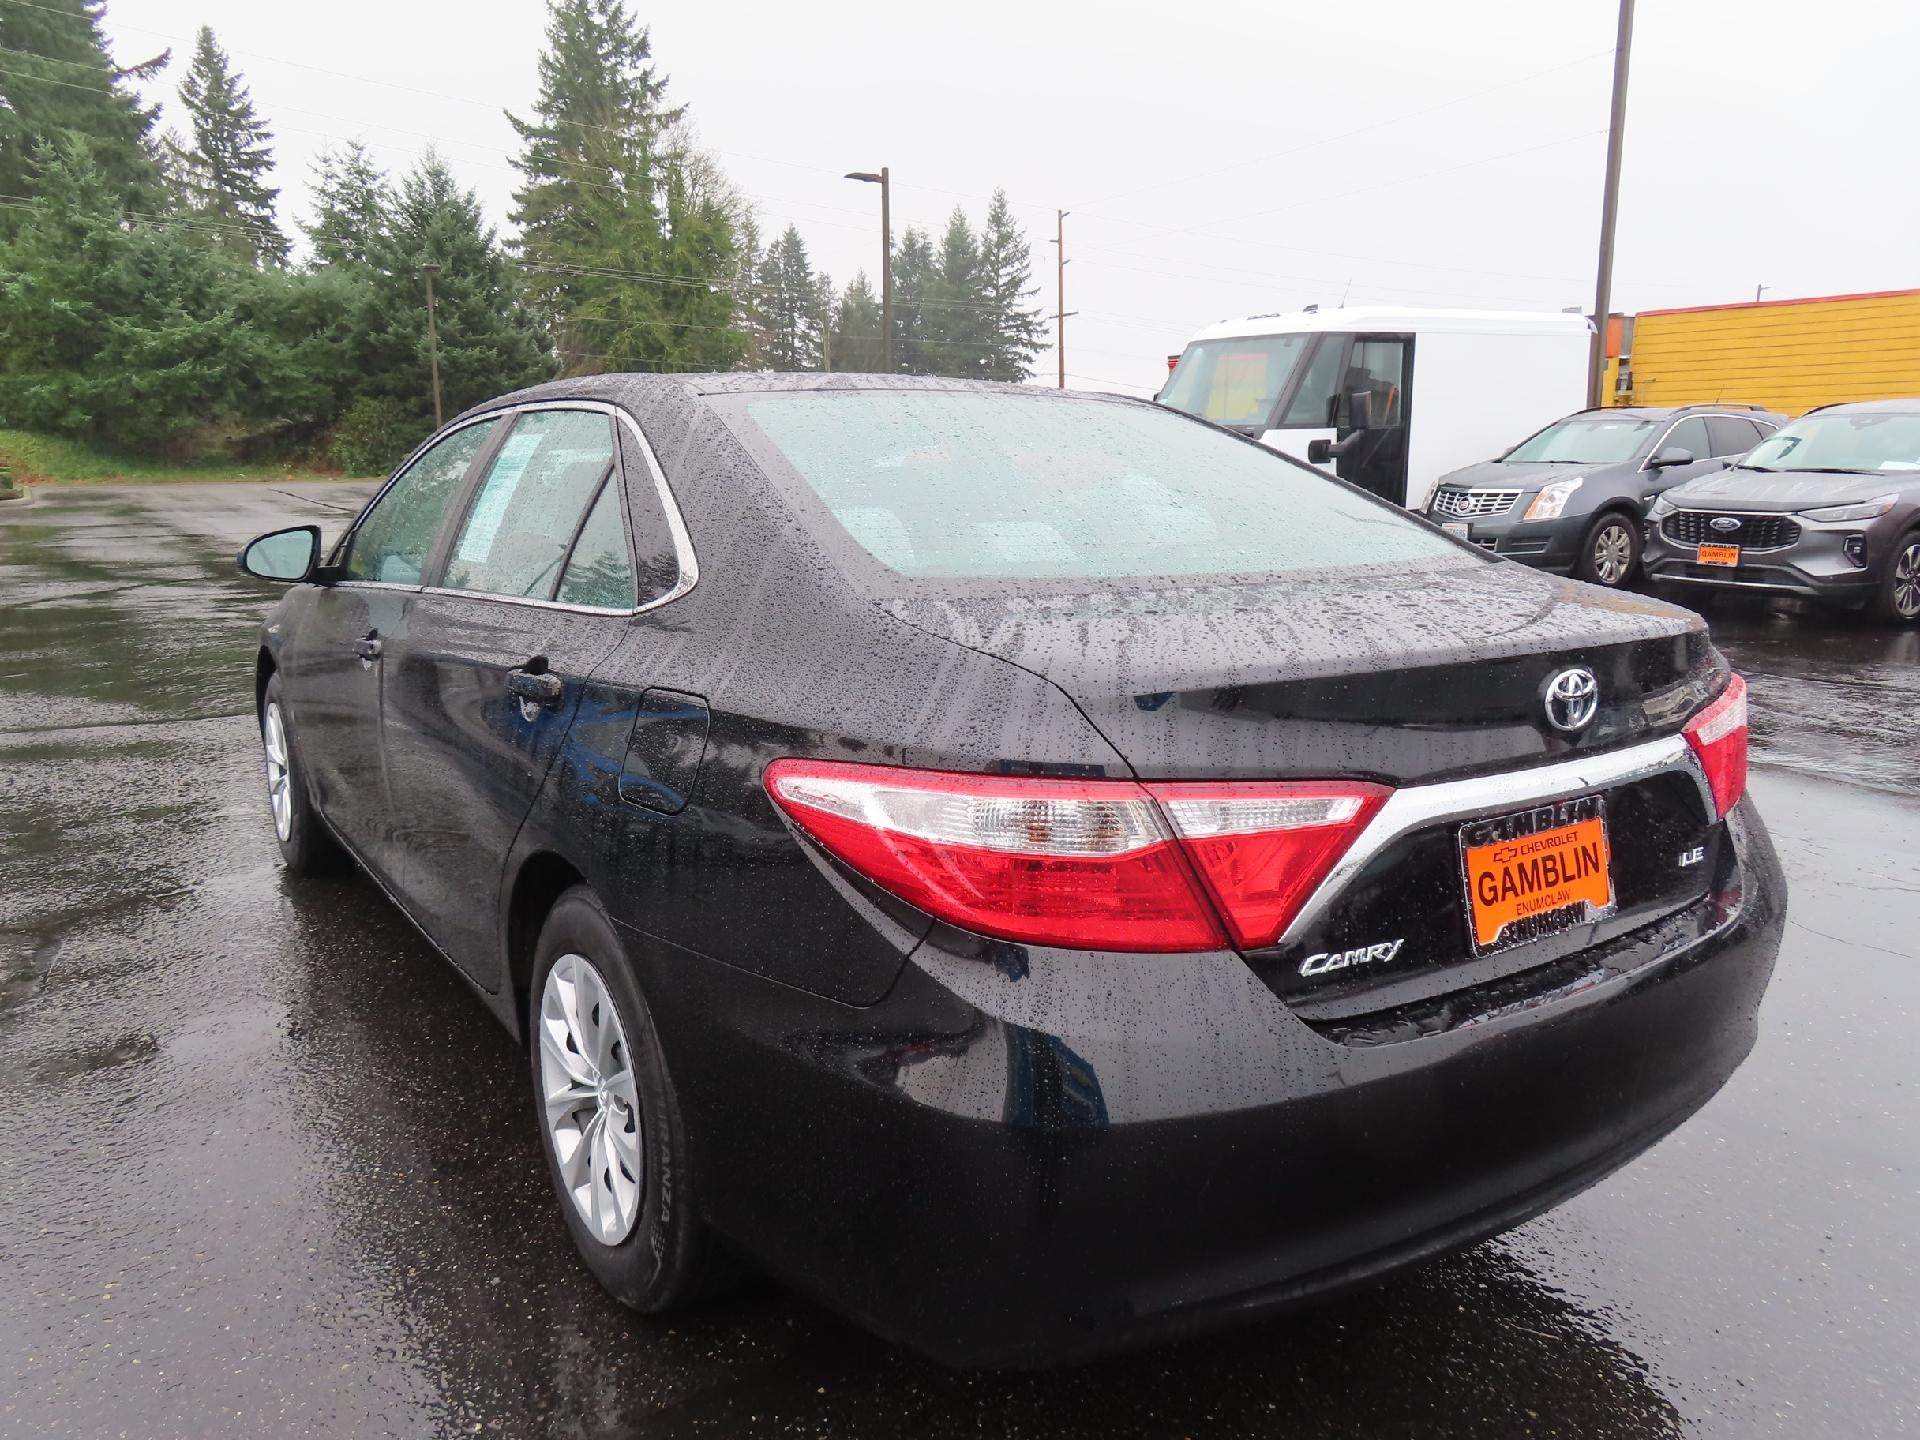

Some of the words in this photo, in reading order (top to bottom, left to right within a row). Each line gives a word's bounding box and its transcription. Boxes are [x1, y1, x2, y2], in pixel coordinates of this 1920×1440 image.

[1520, 831, 1578, 855] CHEVROLET
[1678, 846, 1704, 867] LE
[1478, 842, 1600, 907] GAMBLIN
[1516, 888, 1571, 916] ENUMCLAW
[1299, 938, 1404, 977] CAMRY
